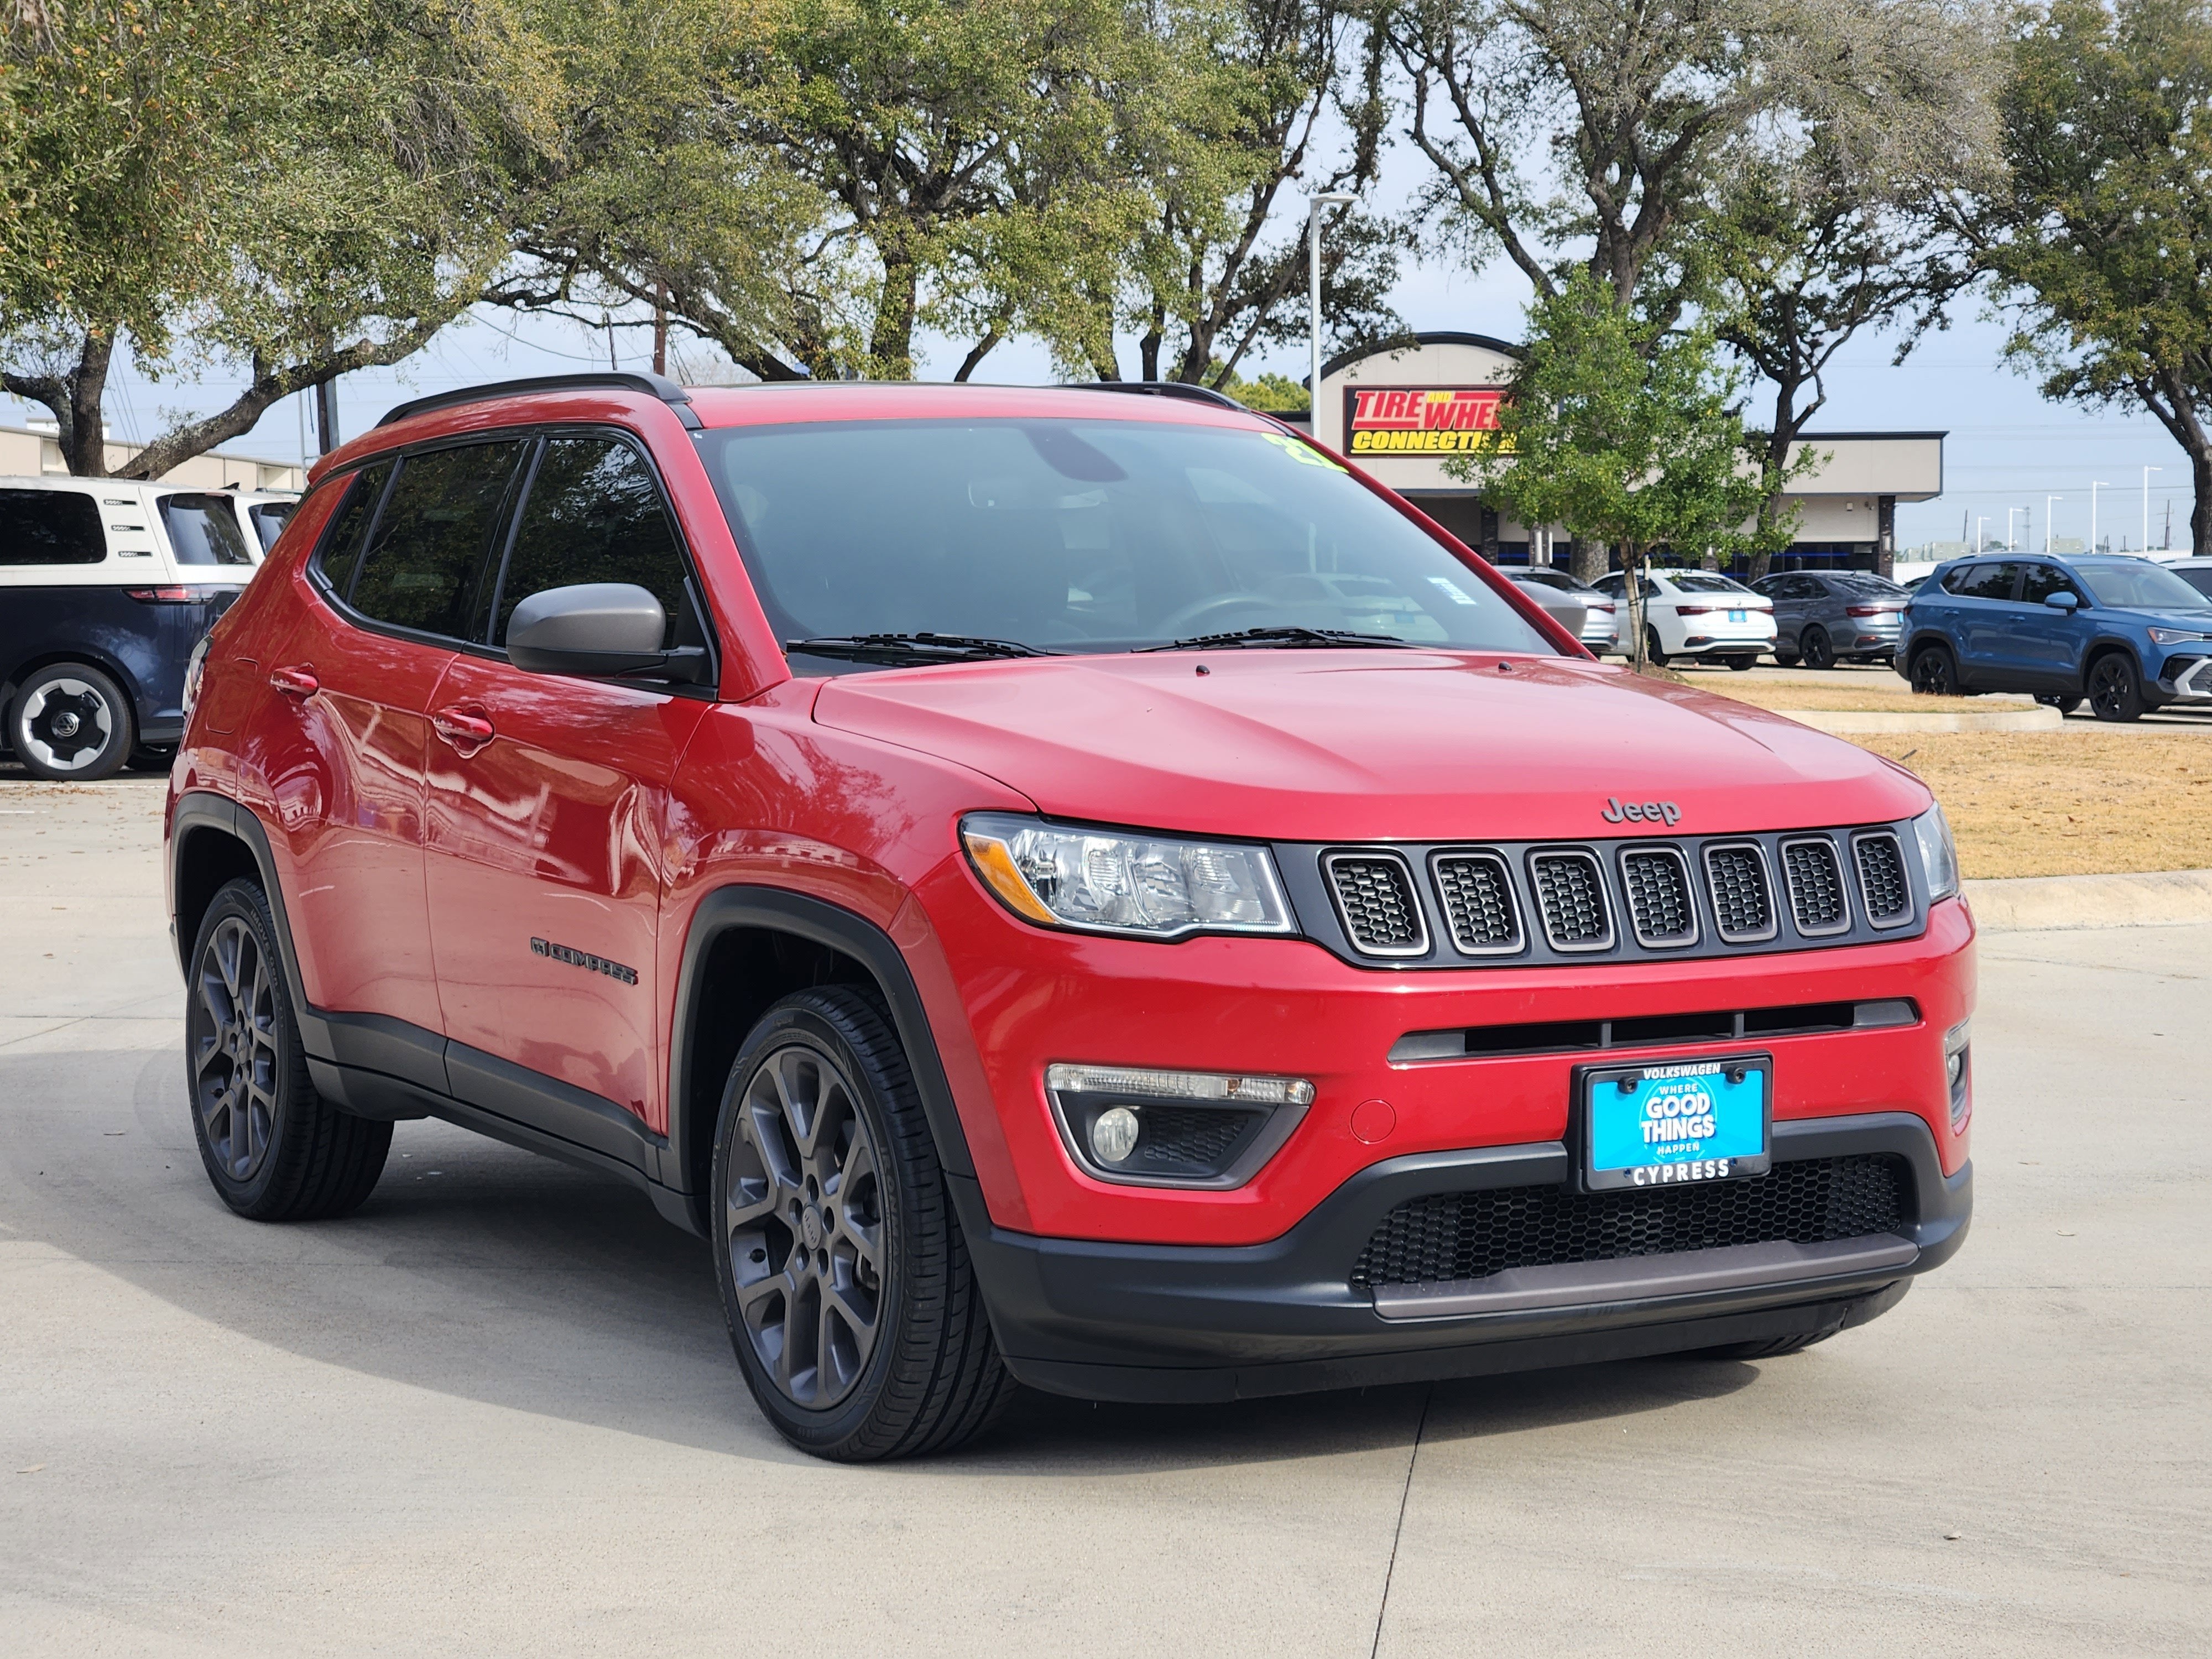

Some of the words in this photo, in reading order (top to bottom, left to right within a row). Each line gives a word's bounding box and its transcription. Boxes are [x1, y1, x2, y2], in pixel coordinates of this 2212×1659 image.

[1354, 390, 1426, 418] TIRE
[1426, 391, 1452, 403] AND
[1423, 401, 1505, 430] WHE
[1601, 797, 1682, 827] Jeep
[550, 943, 639, 985] COMPASS
[1643, 1063, 1721, 1080] VOLKSWAGEN
[1659, 1083, 1698, 1095] WHERE
[1646, 1092, 1711, 1119] GOOD
[1641, 1114, 1715, 1144] THINGS
[1656, 1141, 1700, 1155] HAPPEN
[1633, 1159, 1729, 1186] CYPRESS
